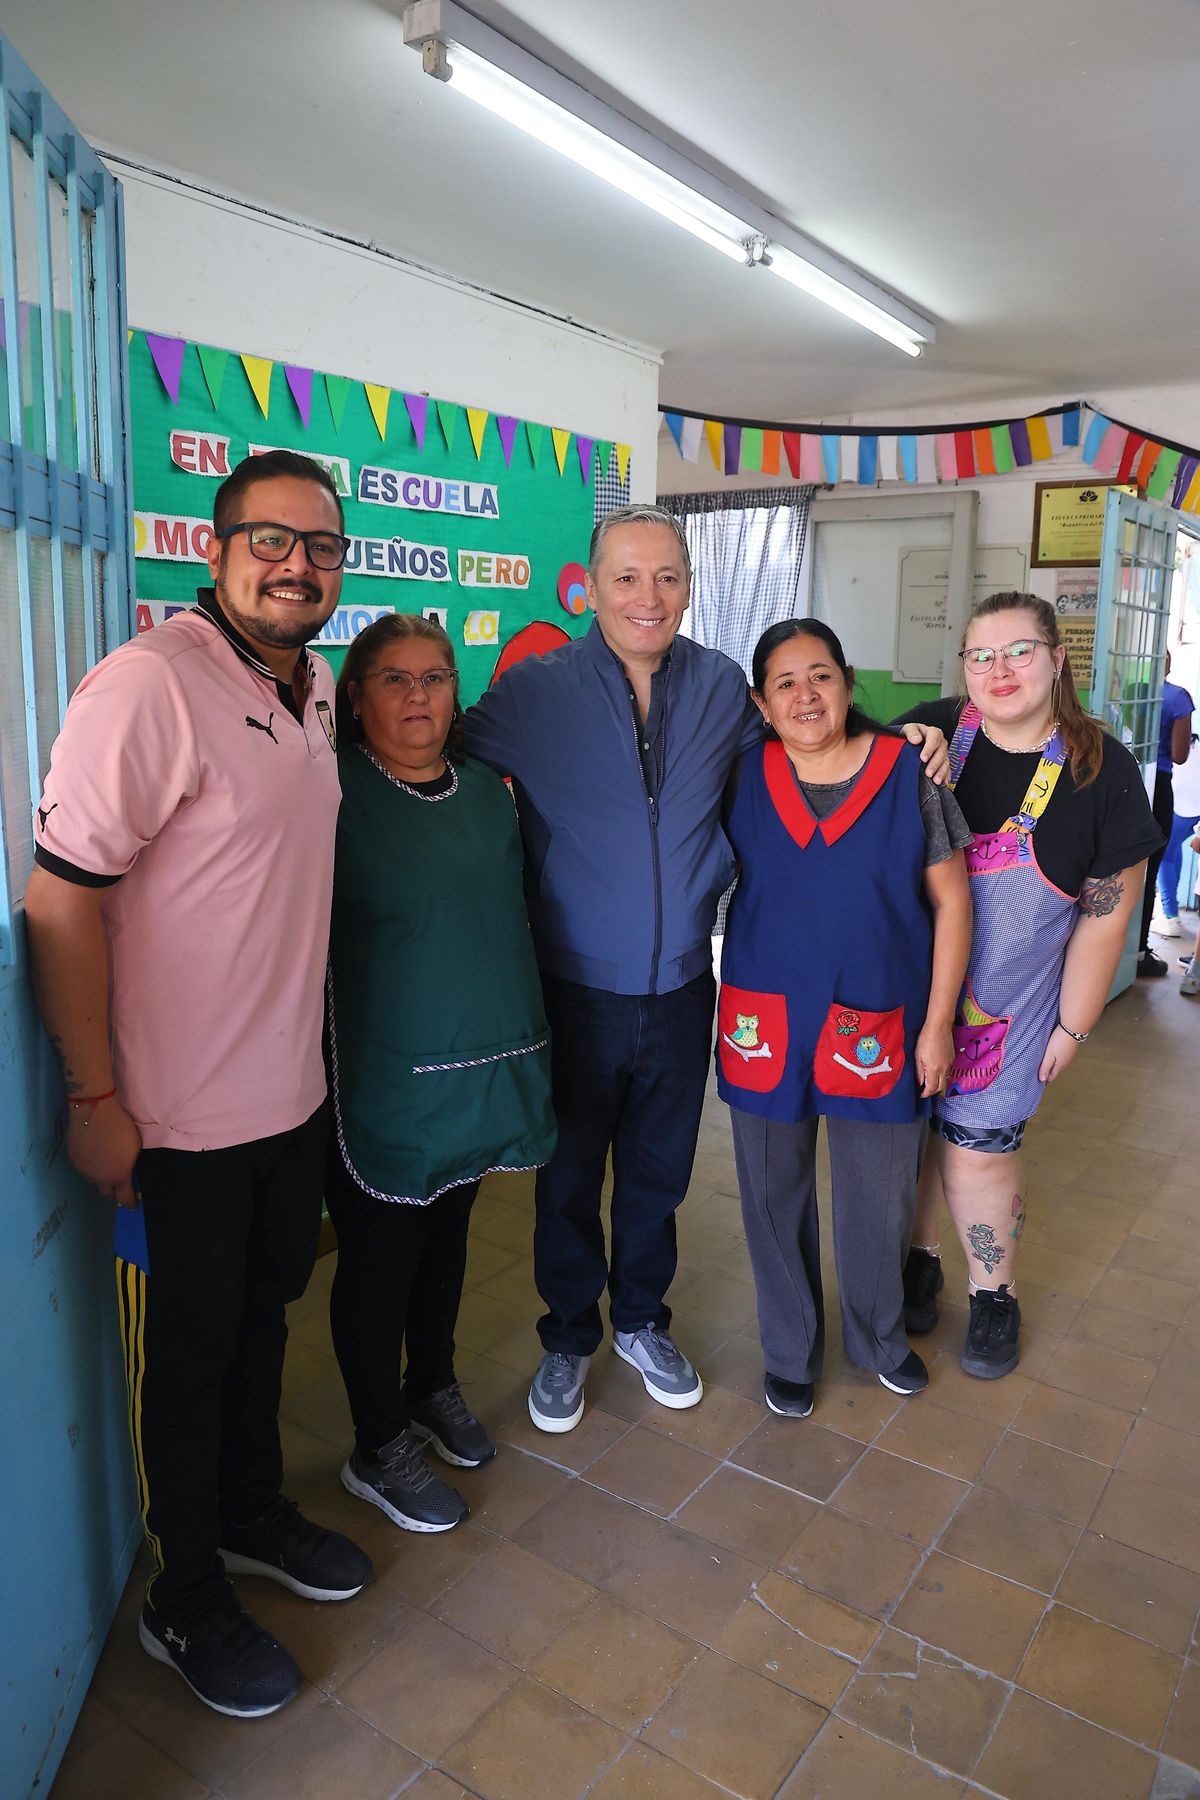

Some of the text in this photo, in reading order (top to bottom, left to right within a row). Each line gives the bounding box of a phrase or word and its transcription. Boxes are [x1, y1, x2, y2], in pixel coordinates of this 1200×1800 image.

[172, 434, 228, 474] EN
[360, 468, 498, 515] ESCUELA
[460, 555, 530, 586] PERO
[465, 613, 498, 641] LO
